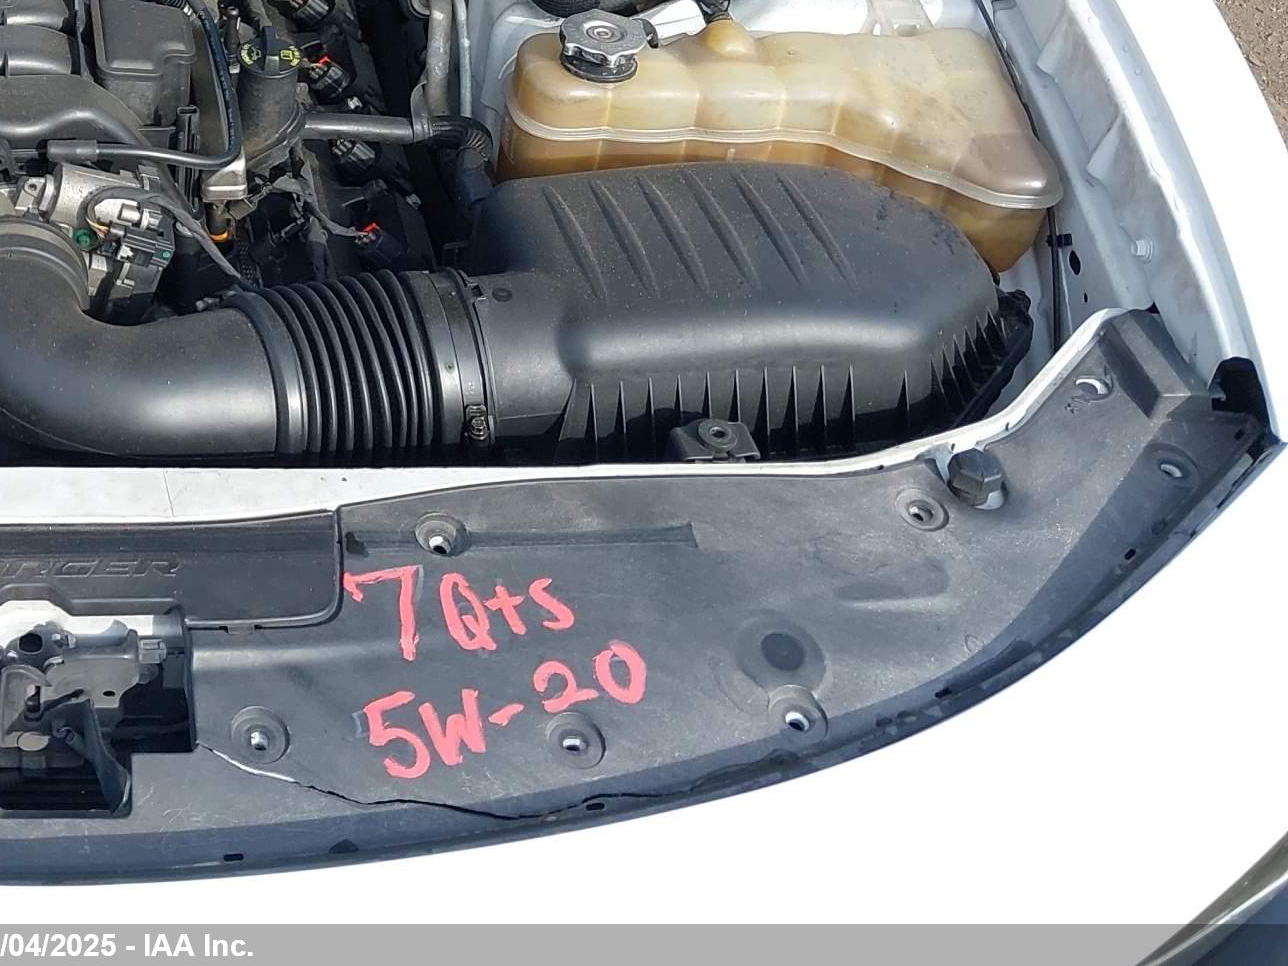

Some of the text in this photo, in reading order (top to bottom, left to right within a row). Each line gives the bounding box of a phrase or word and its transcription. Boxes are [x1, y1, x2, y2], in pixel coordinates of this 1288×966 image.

[343, 565, 575, 661] 7 Qts
[363, 642, 647, 779] 5W-20
